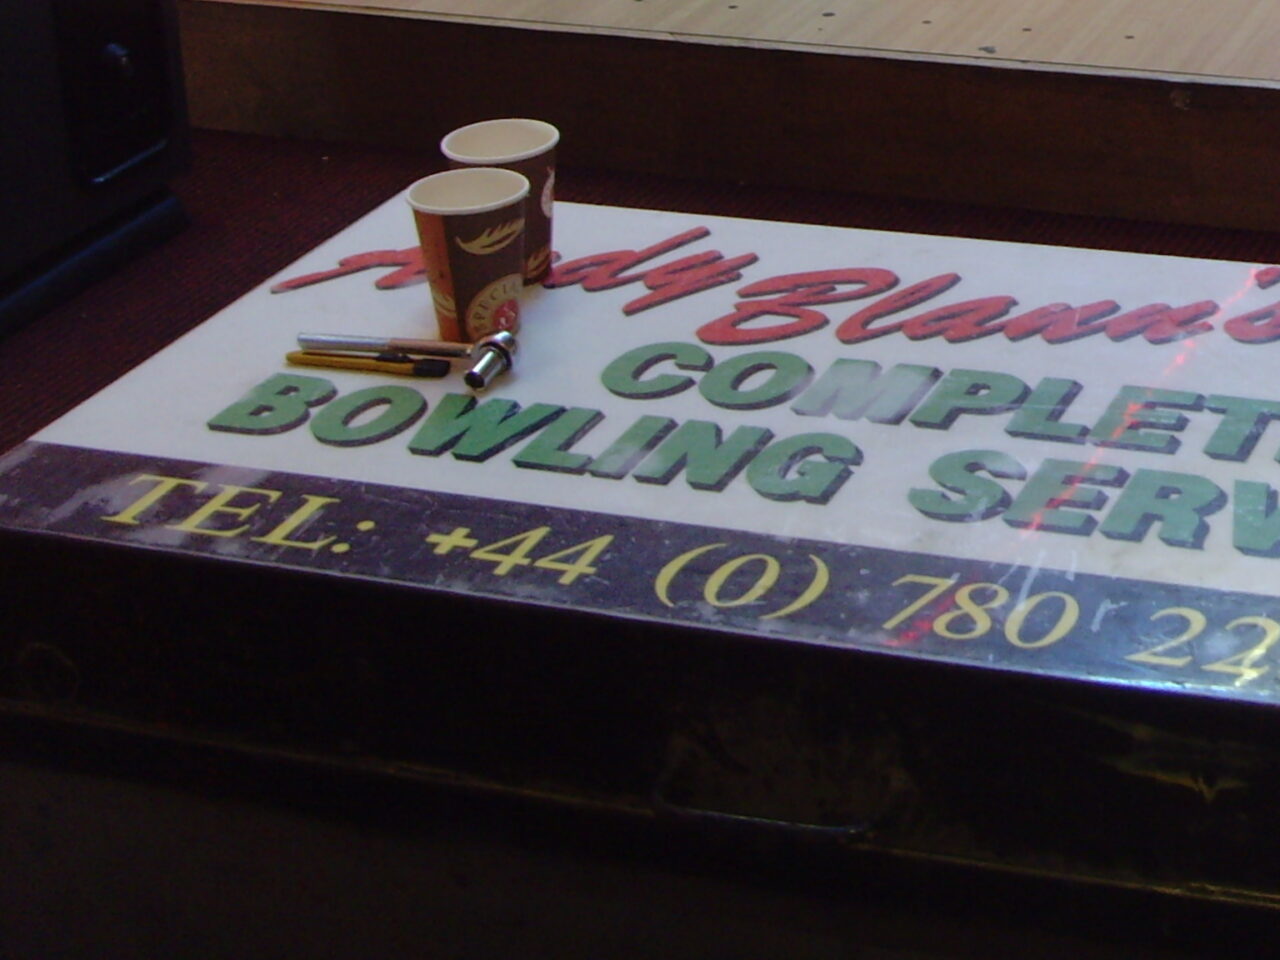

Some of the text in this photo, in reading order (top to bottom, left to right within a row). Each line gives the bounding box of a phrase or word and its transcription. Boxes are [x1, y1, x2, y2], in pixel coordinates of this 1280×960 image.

[206, 372, 865, 505] BOWLING
[101, 473, 375, 554] TEL:
[425, 525, 615, 586] +44
[653, 542, 831, 620] (0)
[882, 573, 1079, 650] 780
